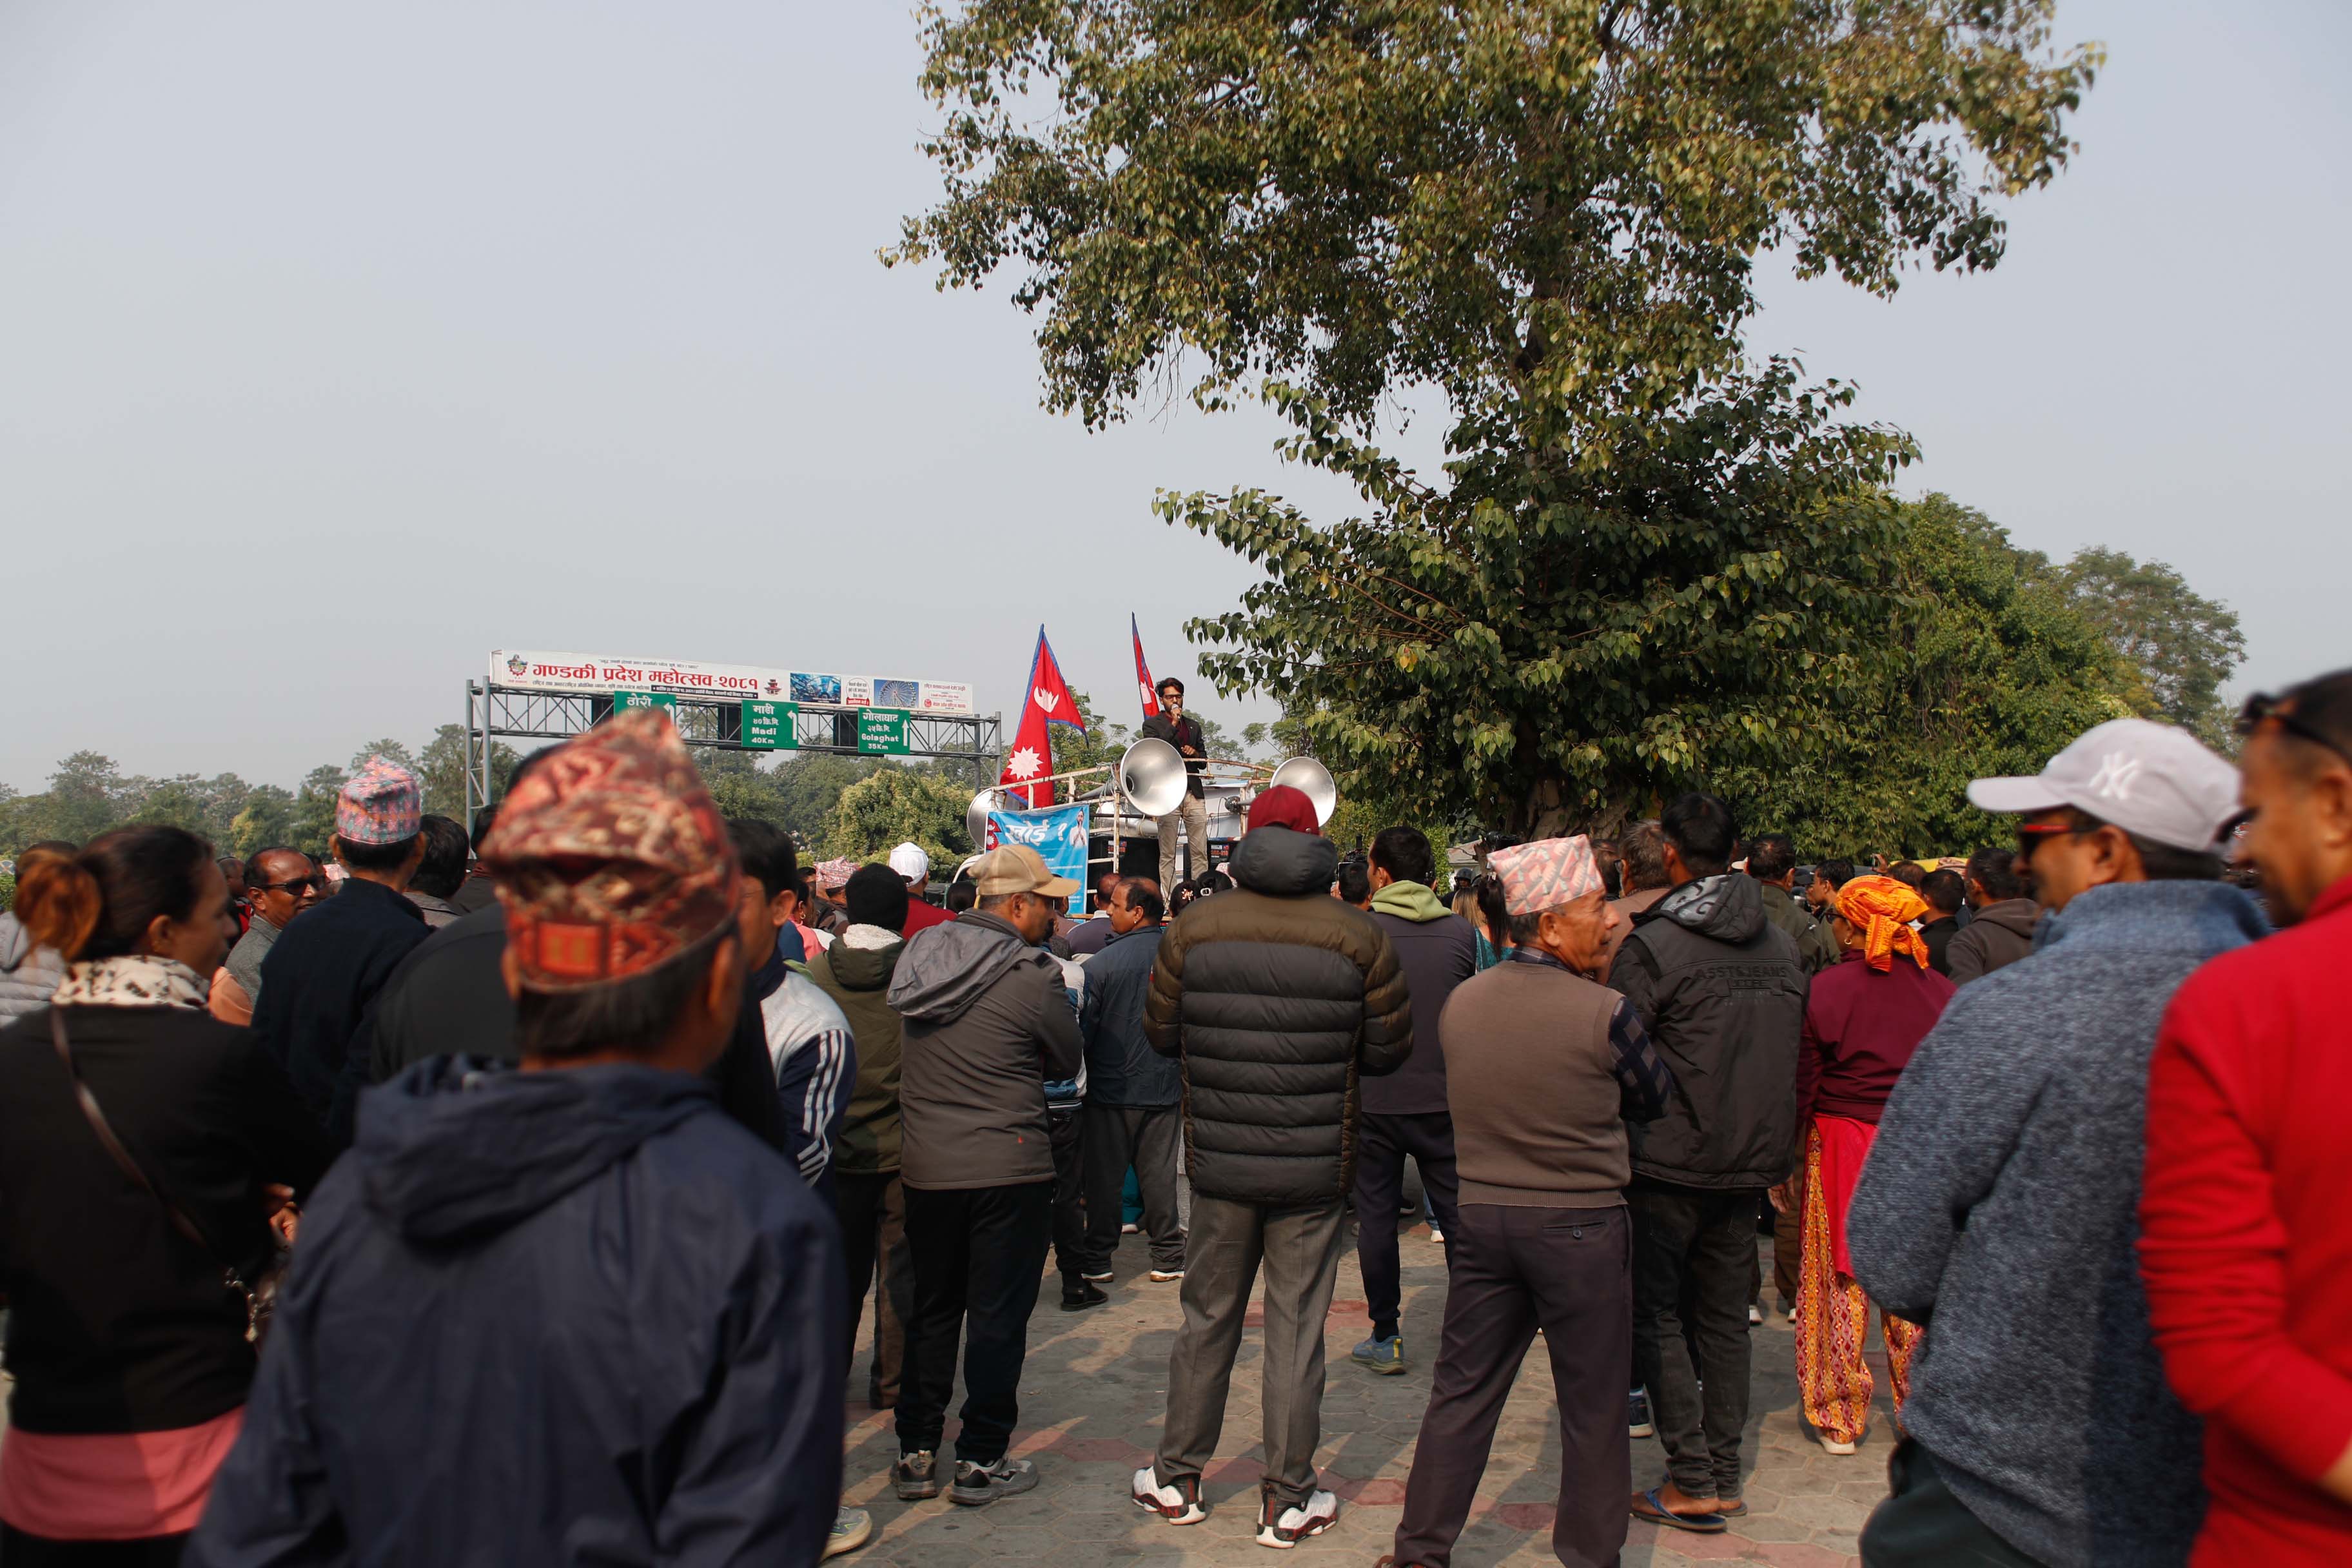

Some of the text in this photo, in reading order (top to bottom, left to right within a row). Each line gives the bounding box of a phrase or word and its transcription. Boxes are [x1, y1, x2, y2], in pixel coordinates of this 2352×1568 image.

[533, 663, 596, 680] गण्डकी
[603, 665, 643, 682] प्रदेश
[627, 693, 652, 708] ठोरी
[862, 709, 899, 722] गोलाघाट
[751, 727, 776, 735] Madi
[861, 733, 899, 743] Golaghat
[1004, 819, 1050, 847] खोई
